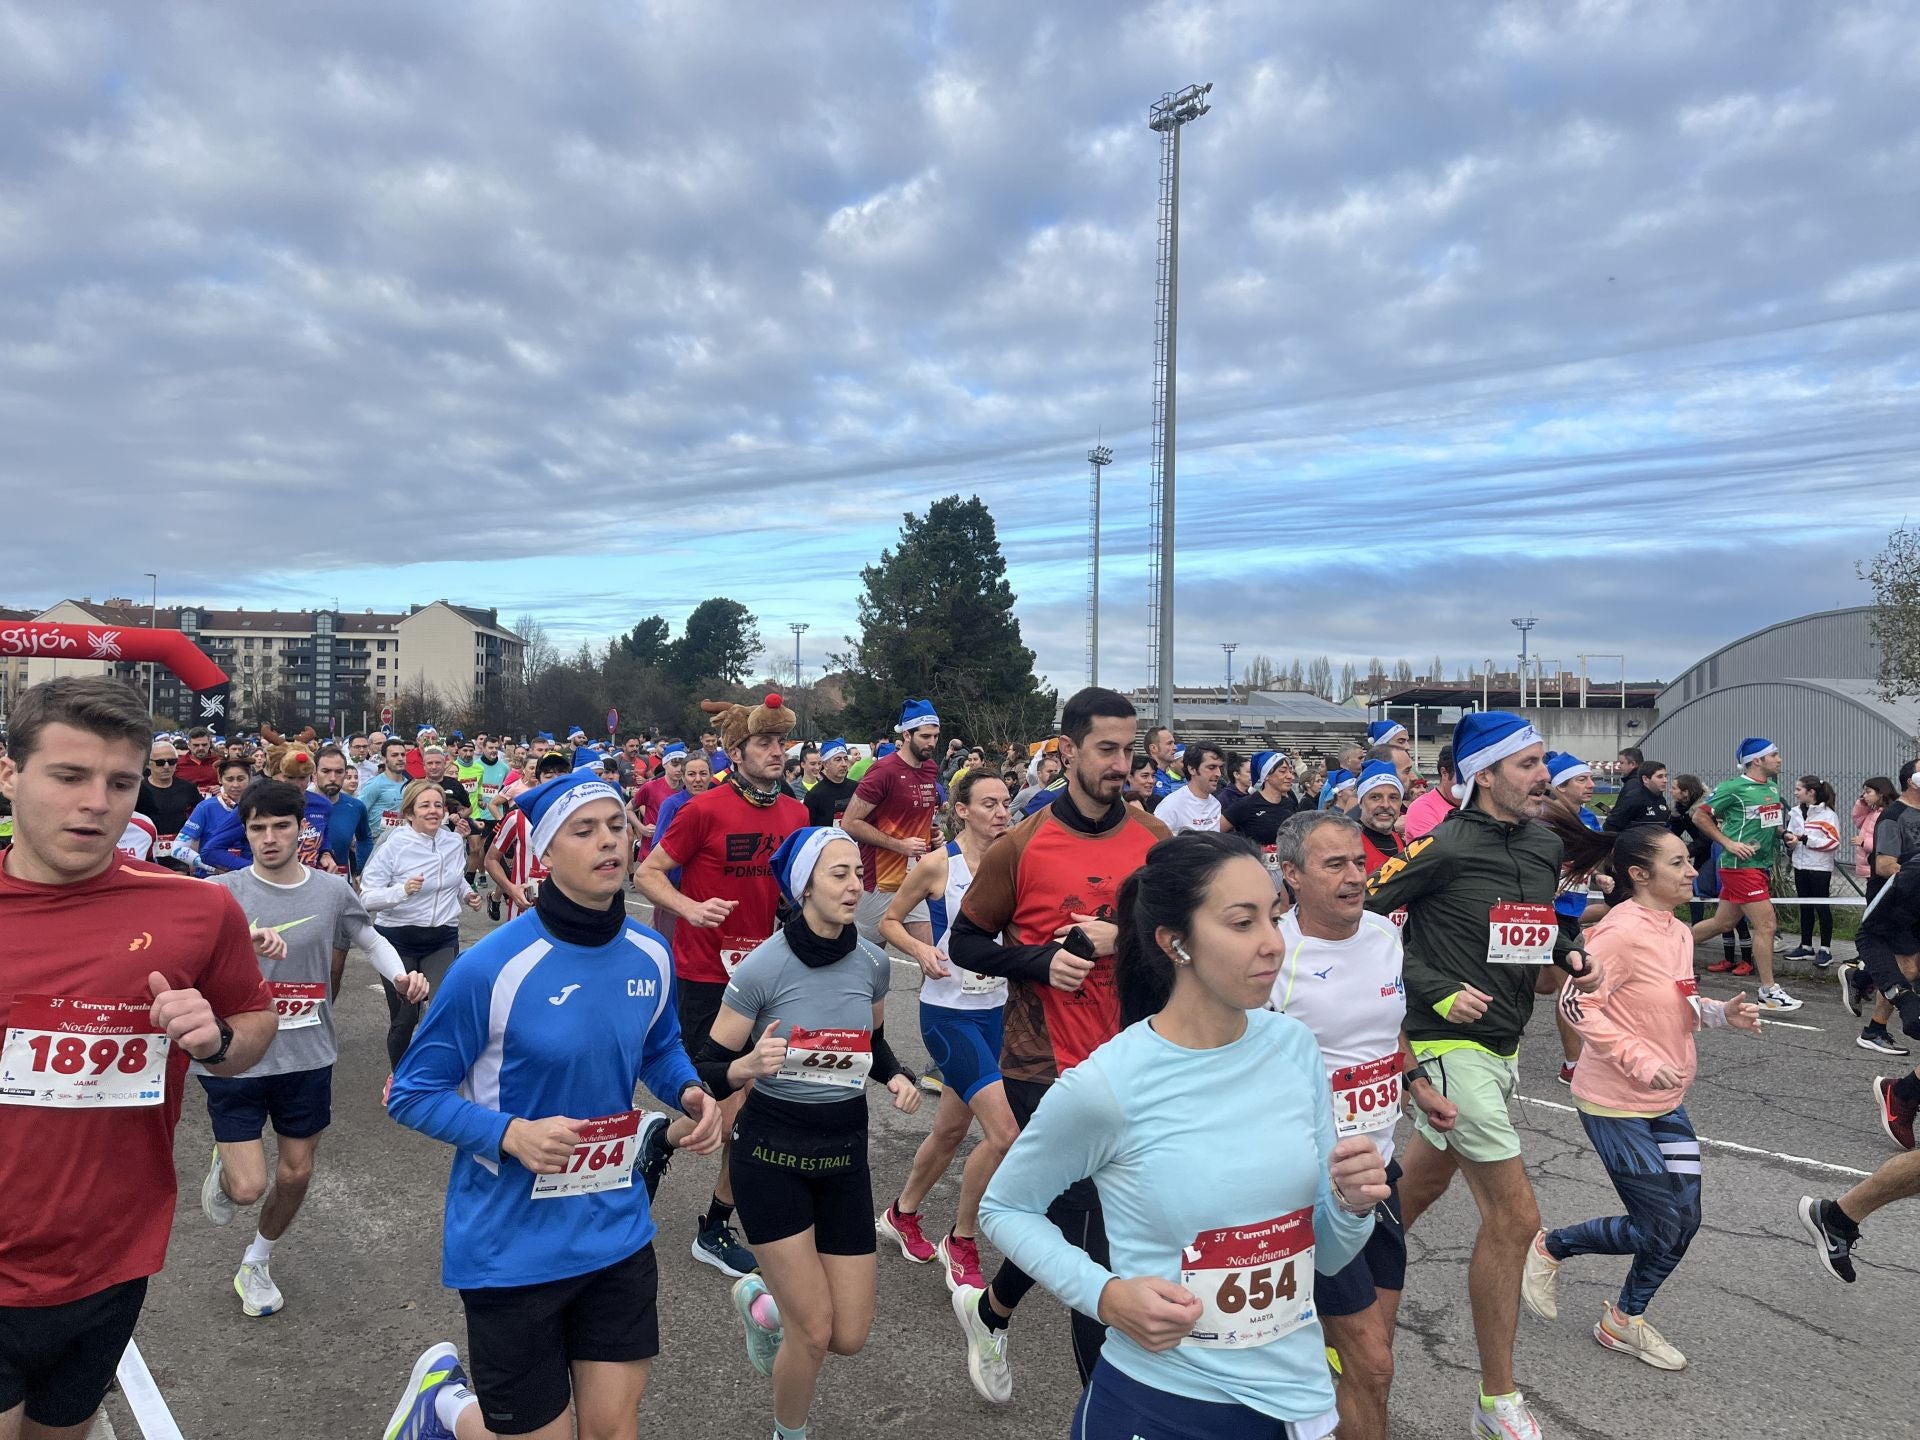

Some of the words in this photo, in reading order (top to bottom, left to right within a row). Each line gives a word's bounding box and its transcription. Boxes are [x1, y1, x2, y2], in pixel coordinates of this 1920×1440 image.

[1, 627, 78, 654] gijón
[1764, 812, 1778, 820] 1773
[1499, 925, 1550, 946] 1029
[627, 979, 656, 997] CAM
[1381, 987, 1396, 997] Run
[50, 998, 64, 1008] 37
[73, 1000, 116, 1011] Carrera
[117, 1002, 150, 1013] Popula
[97, 1013, 110, 1022] de
[58, 1022, 134, 1034] Nochebuena
[28, 1034, 148, 1076] 1898
[802, 1052, 853, 1070] 626
[73, 1079, 98, 1087] JAIME
[1344, 1078, 1398, 1114] 1038
[752, 1145, 796, 1168] ALLER
[800, 1157, 817, 1171] ES
[818, 1154, 851, 1170] TRAIL
[1214, 1232, 1227, 1243] 37
[1235, 1227, 1271, 1240] Carrera
[1258, 1240, 1269, 1249] de
[1225, 1247, 1290, 1267] Nochebuena
[1216, 1260, 1297, 1314] 654
[1249, 1313, 1274, 1324] MARTA
